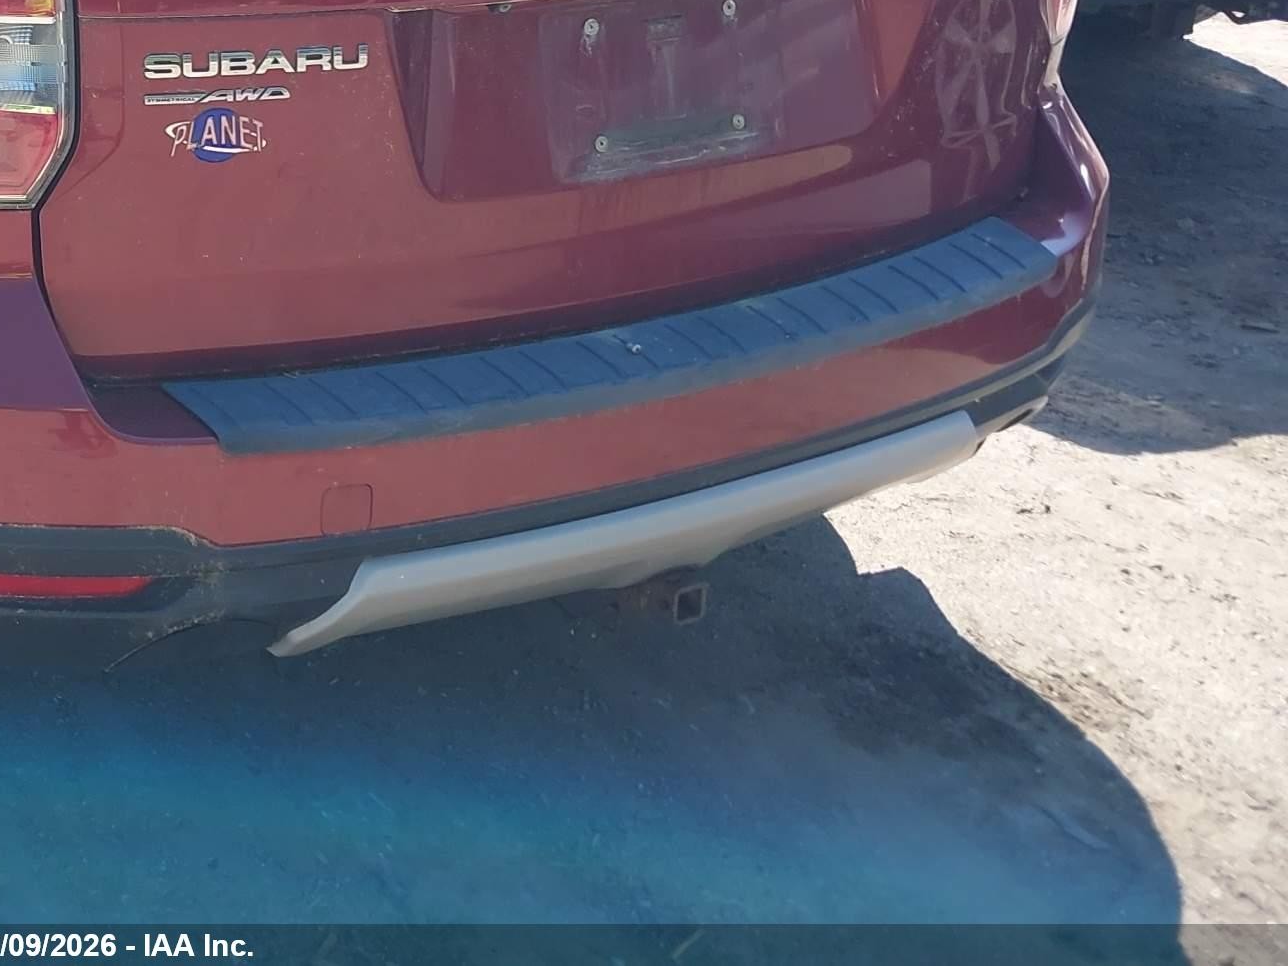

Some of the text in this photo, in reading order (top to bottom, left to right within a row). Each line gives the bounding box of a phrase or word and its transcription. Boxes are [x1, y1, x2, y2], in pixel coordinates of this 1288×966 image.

[143, 43, 369, 79] SUBARU
[200, 86, 291, 103] AWD
[169, 114, 264, 157] PLANET
